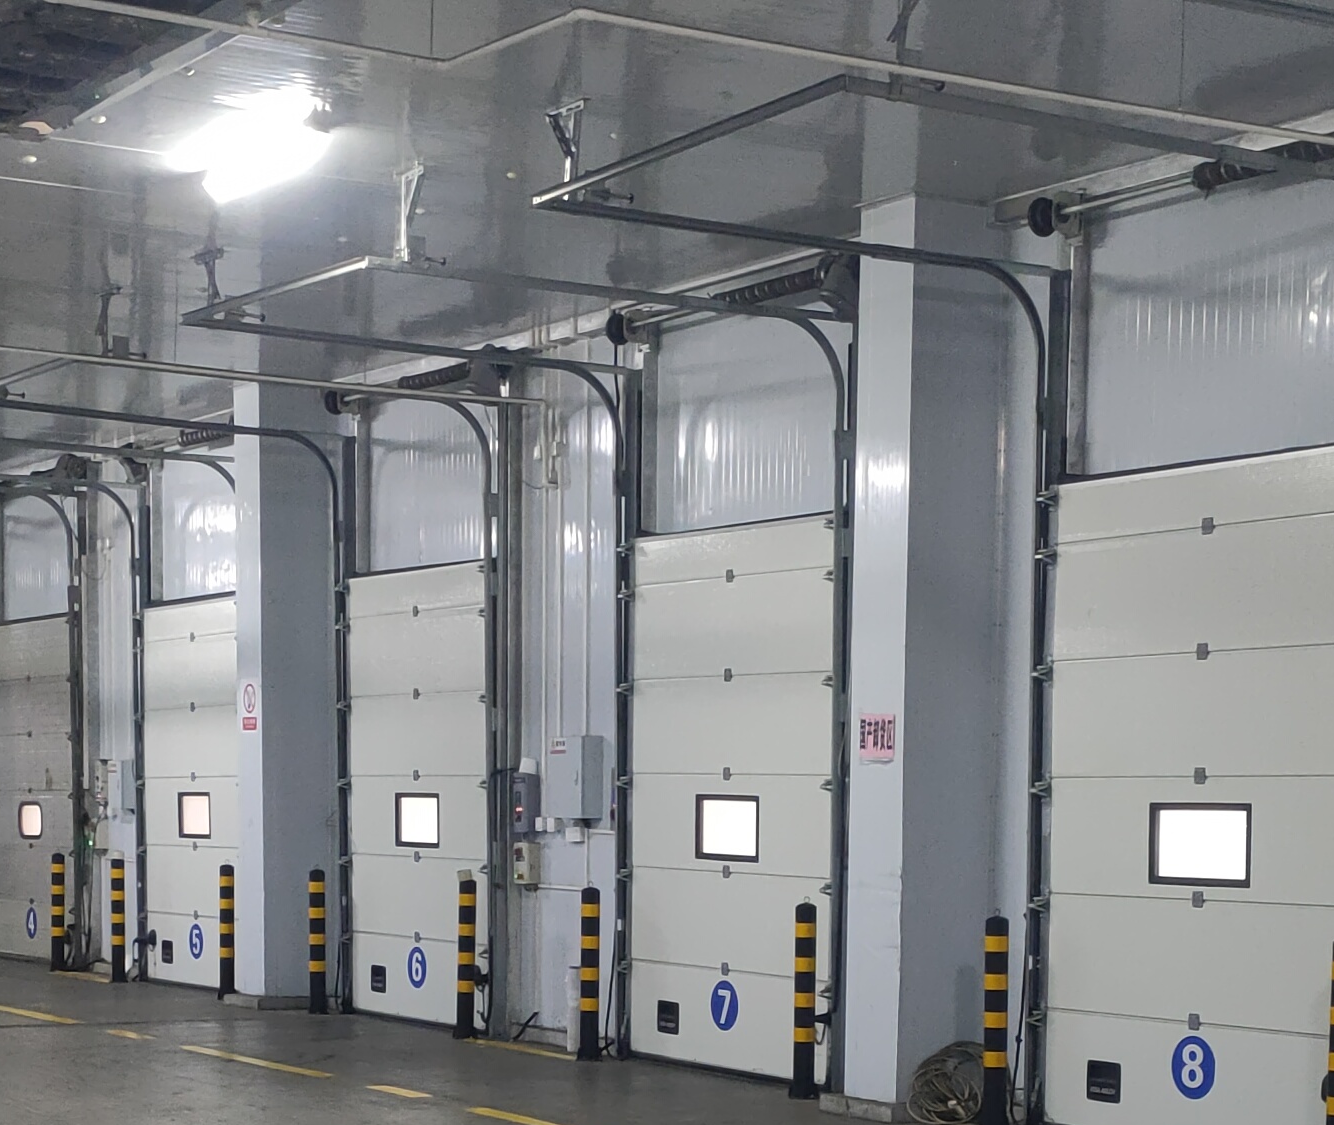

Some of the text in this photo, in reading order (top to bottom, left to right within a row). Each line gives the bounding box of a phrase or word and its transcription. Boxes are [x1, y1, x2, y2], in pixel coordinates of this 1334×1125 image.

[192, 929, 201, 955] 5
[411, 952, 423, 982] 6
[717, 988, 732, 1025] 7
[1181, 1043, 1204, 1089] 8
